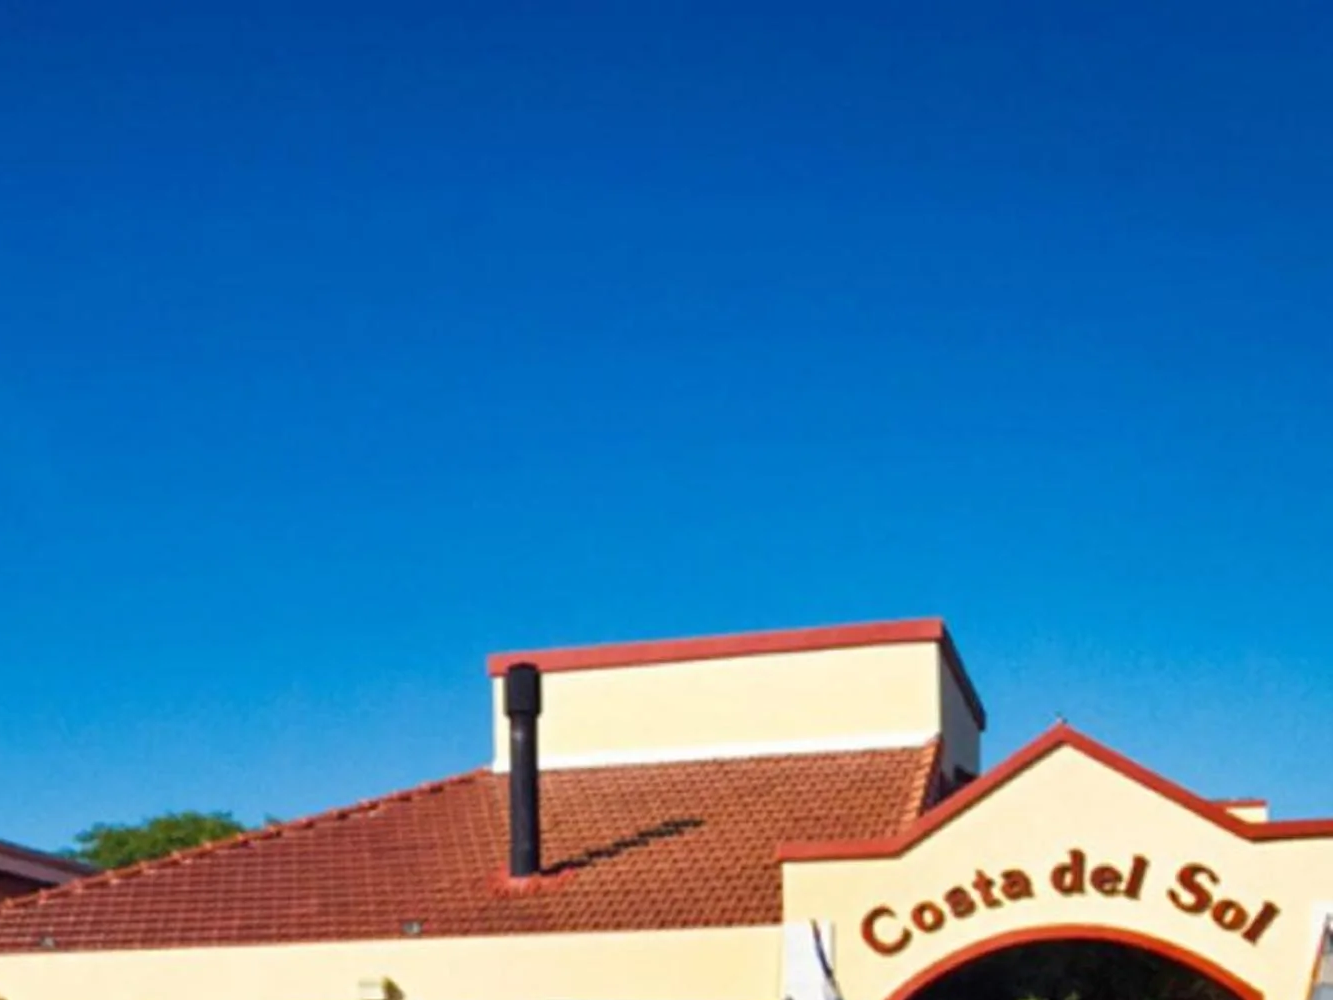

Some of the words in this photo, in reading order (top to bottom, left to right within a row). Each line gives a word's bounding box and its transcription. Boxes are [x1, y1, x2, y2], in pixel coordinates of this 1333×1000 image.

[861, 868, 1035, 956] Costa
[1050, 848, 1150, 900] del
[1167, 862, 1280, 945] Sol
